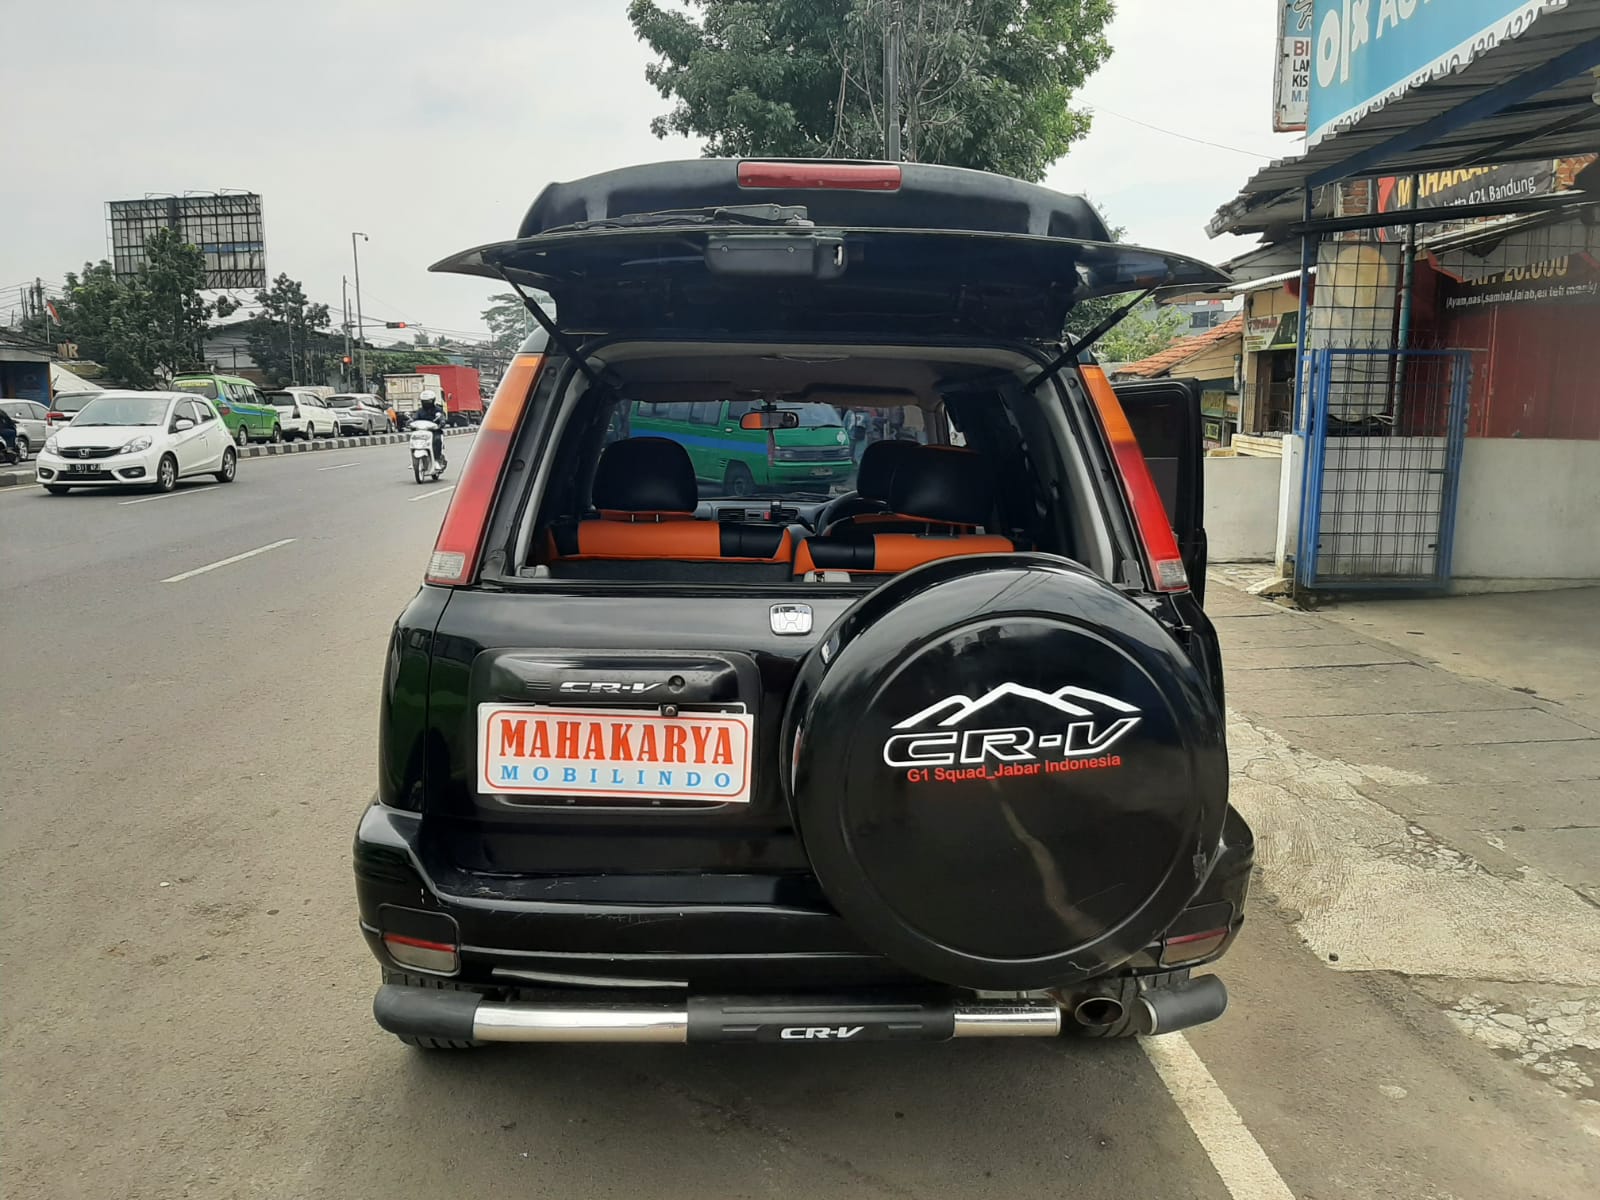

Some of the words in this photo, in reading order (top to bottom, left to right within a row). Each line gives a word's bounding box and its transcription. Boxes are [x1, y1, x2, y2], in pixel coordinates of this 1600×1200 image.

[1489, 176, 1537, 202] Bandung
[559, 681, 664, 694] CR-V
[499, 719, 734, 765] MAHAKARYA
[883, 716, 1143, 767] CR-V
[500, 765, 731, 788] MOBILINDO
[907, 767, 930, 783] G1
[934, 761, 1041, 784] Squad_Jabar
[1044, 752, 1122, 774] Indonesia
[780, 1026, 865, 1039] CR-V
